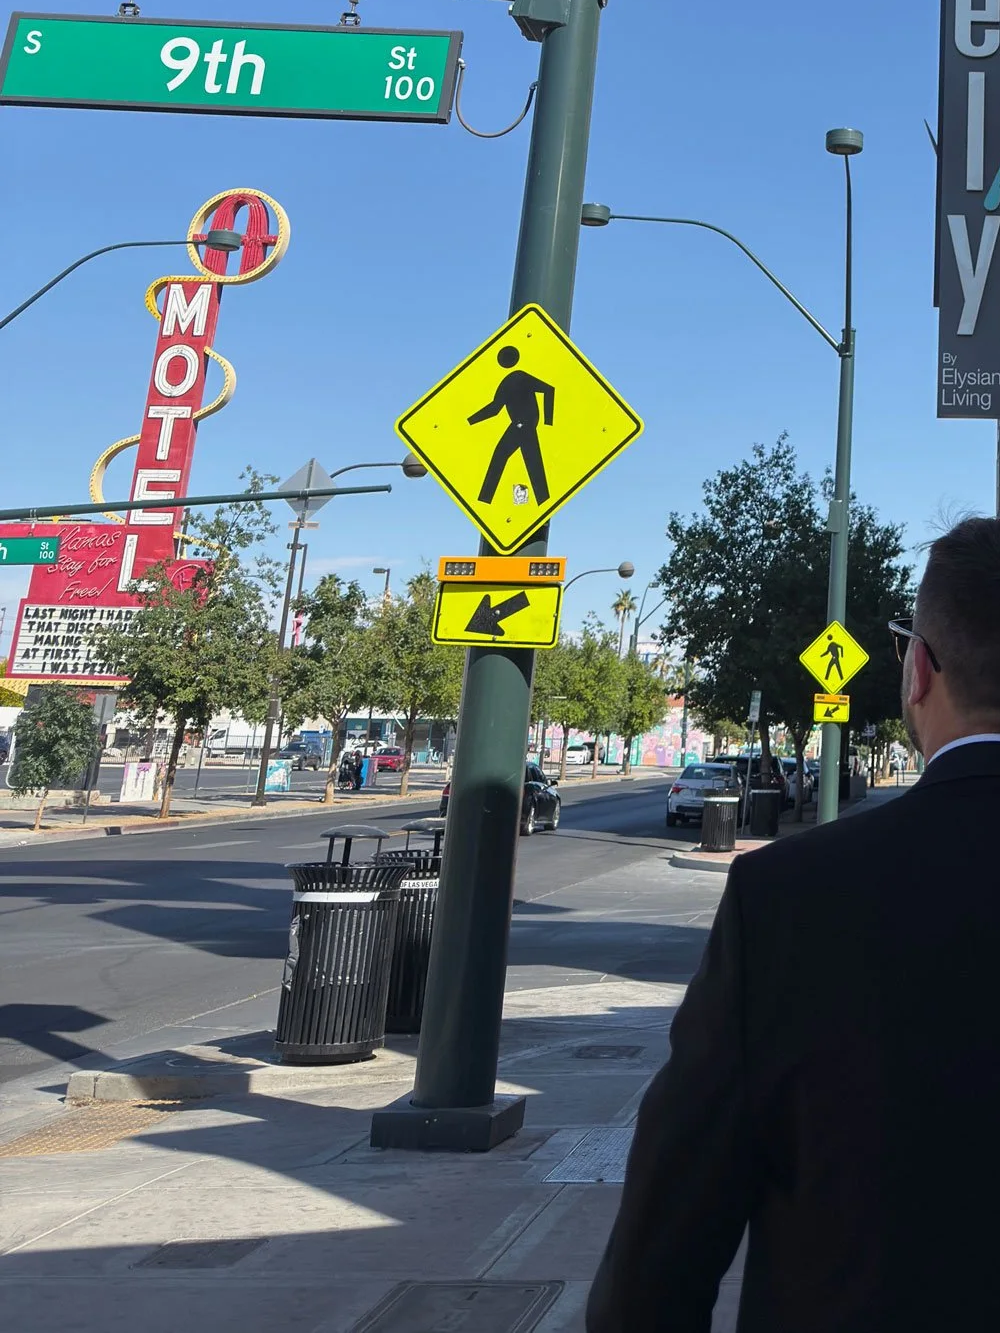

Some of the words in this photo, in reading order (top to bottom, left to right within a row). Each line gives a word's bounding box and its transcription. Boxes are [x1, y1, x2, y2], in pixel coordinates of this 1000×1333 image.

[23, 30, 43, 54] S
[160, 37, 266, 95] 9th
[388, 46, 417, 70] St
[383, 76, 435, 101] 100
[942, 353, 957, 367] By
[941, 389, 992, 411] Living
[117, 282, 213, 592] MOTEL
[40, 541, 50, 550] St
[39, 550, 54, 559] 100
[88, 550, 117, 574] for
[24, 607, 56, 619] LAST
[59, 607, 97, 621] NIGHT
[28, 621, 61, 633] THAT
[33, 634, 81, 648] MAKING
[21, 648, 39, 659] AT
[50, 662, 79, 674] WAS
[421, 880, 438, 888] VEGA
